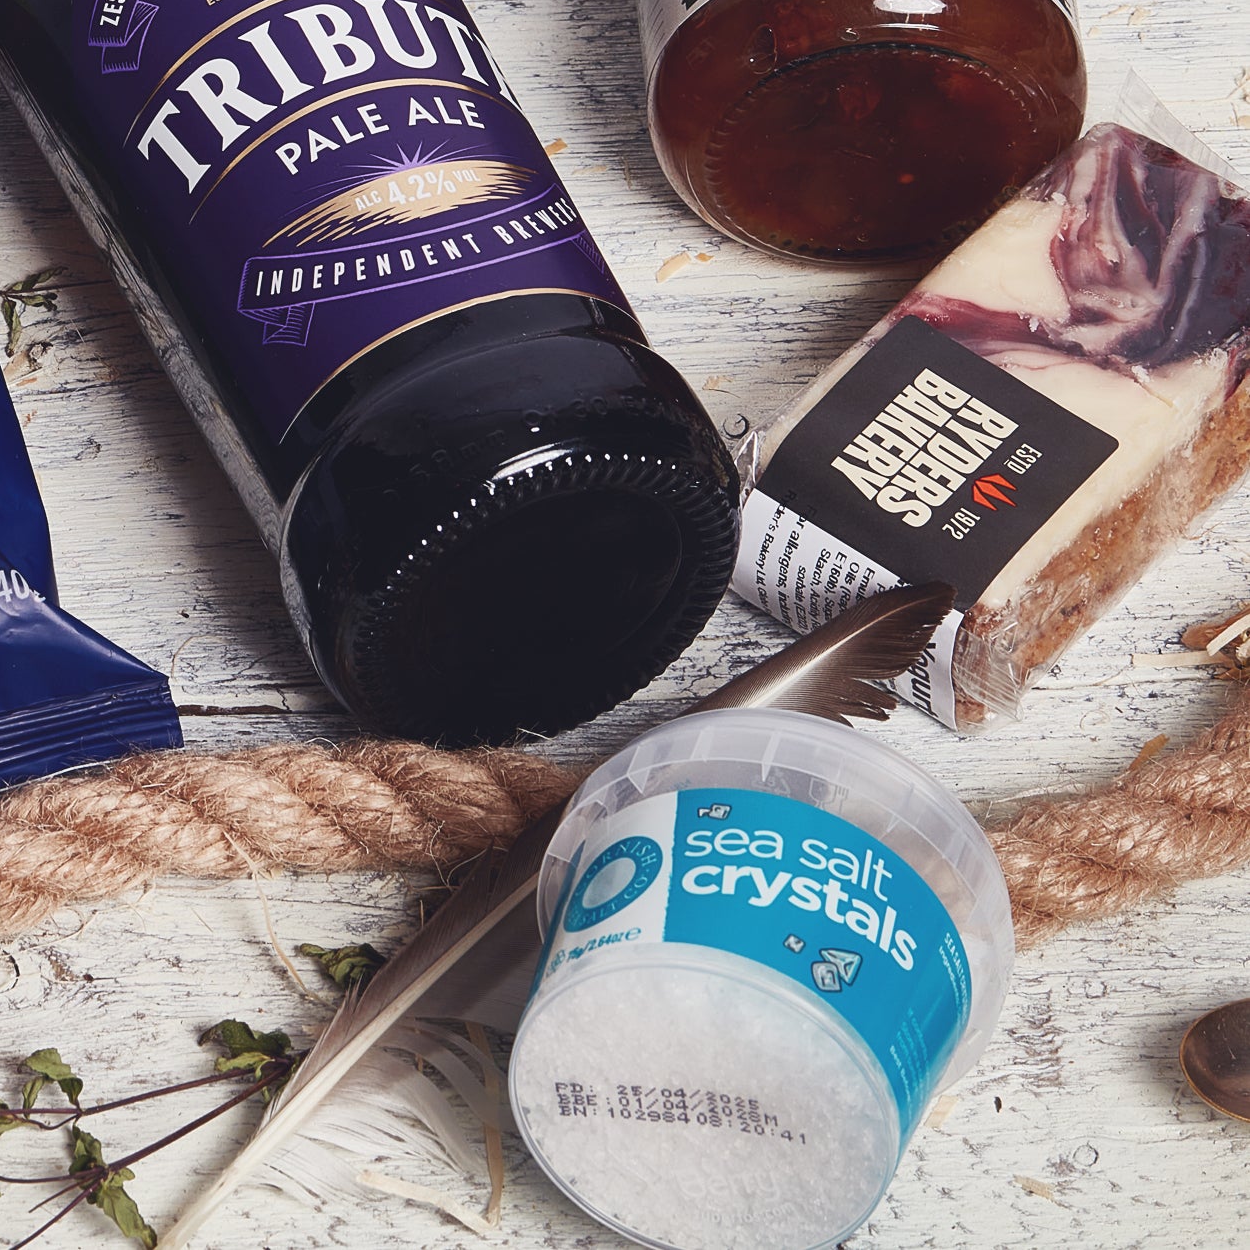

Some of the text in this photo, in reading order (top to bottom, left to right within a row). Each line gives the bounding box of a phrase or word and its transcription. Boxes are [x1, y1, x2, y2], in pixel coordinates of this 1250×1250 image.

[275, 96, 485, 176] PALE ALE
[355, 169, 482, 212] ALC 4.2% VOL
[255, 233, 482, 297] INDEPENDENT
[831, 368, 971, 501] BAKERY
[876, 398, 1019, 528] RYDERS
[942, 508, 982, 540] 1972
[685, 828, 893, 901] sea salt
[681, 862, 917, 972] crystals
